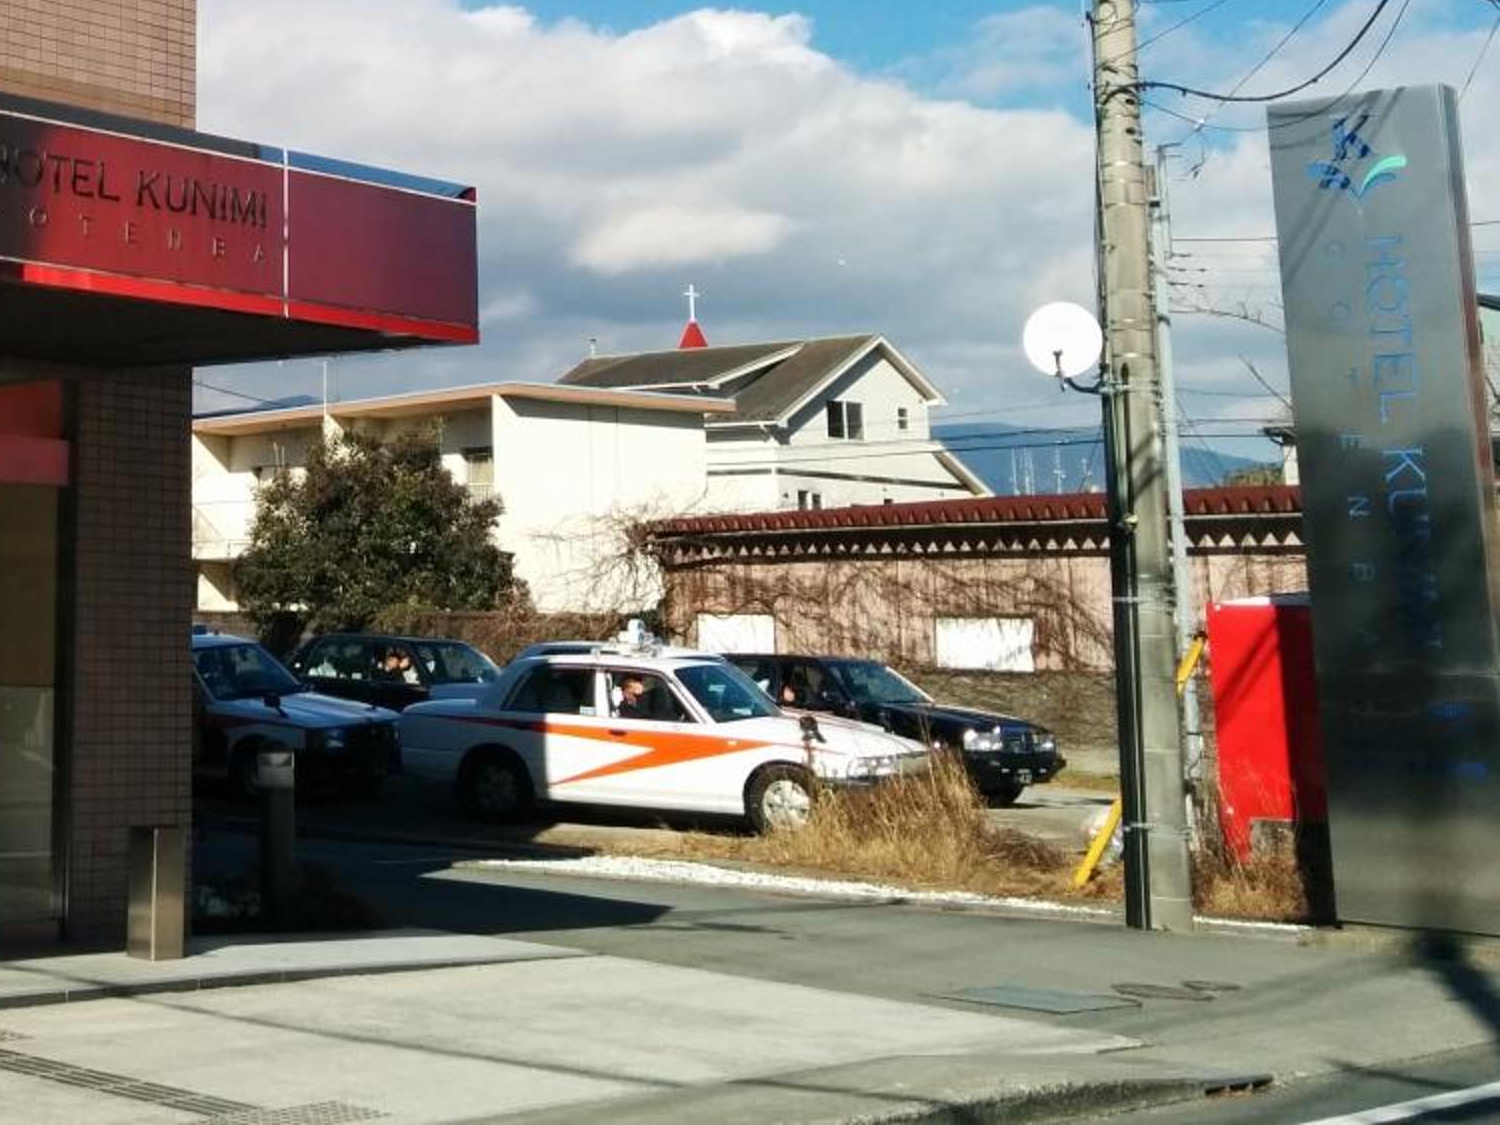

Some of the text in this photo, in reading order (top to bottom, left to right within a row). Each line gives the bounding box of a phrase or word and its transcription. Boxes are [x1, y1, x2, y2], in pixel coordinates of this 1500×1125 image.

[1331, 115, 1374, 160] K
[137, 170, 267, 227] KUNIMI
[1365, 236, 1417, 424] HOTEL
